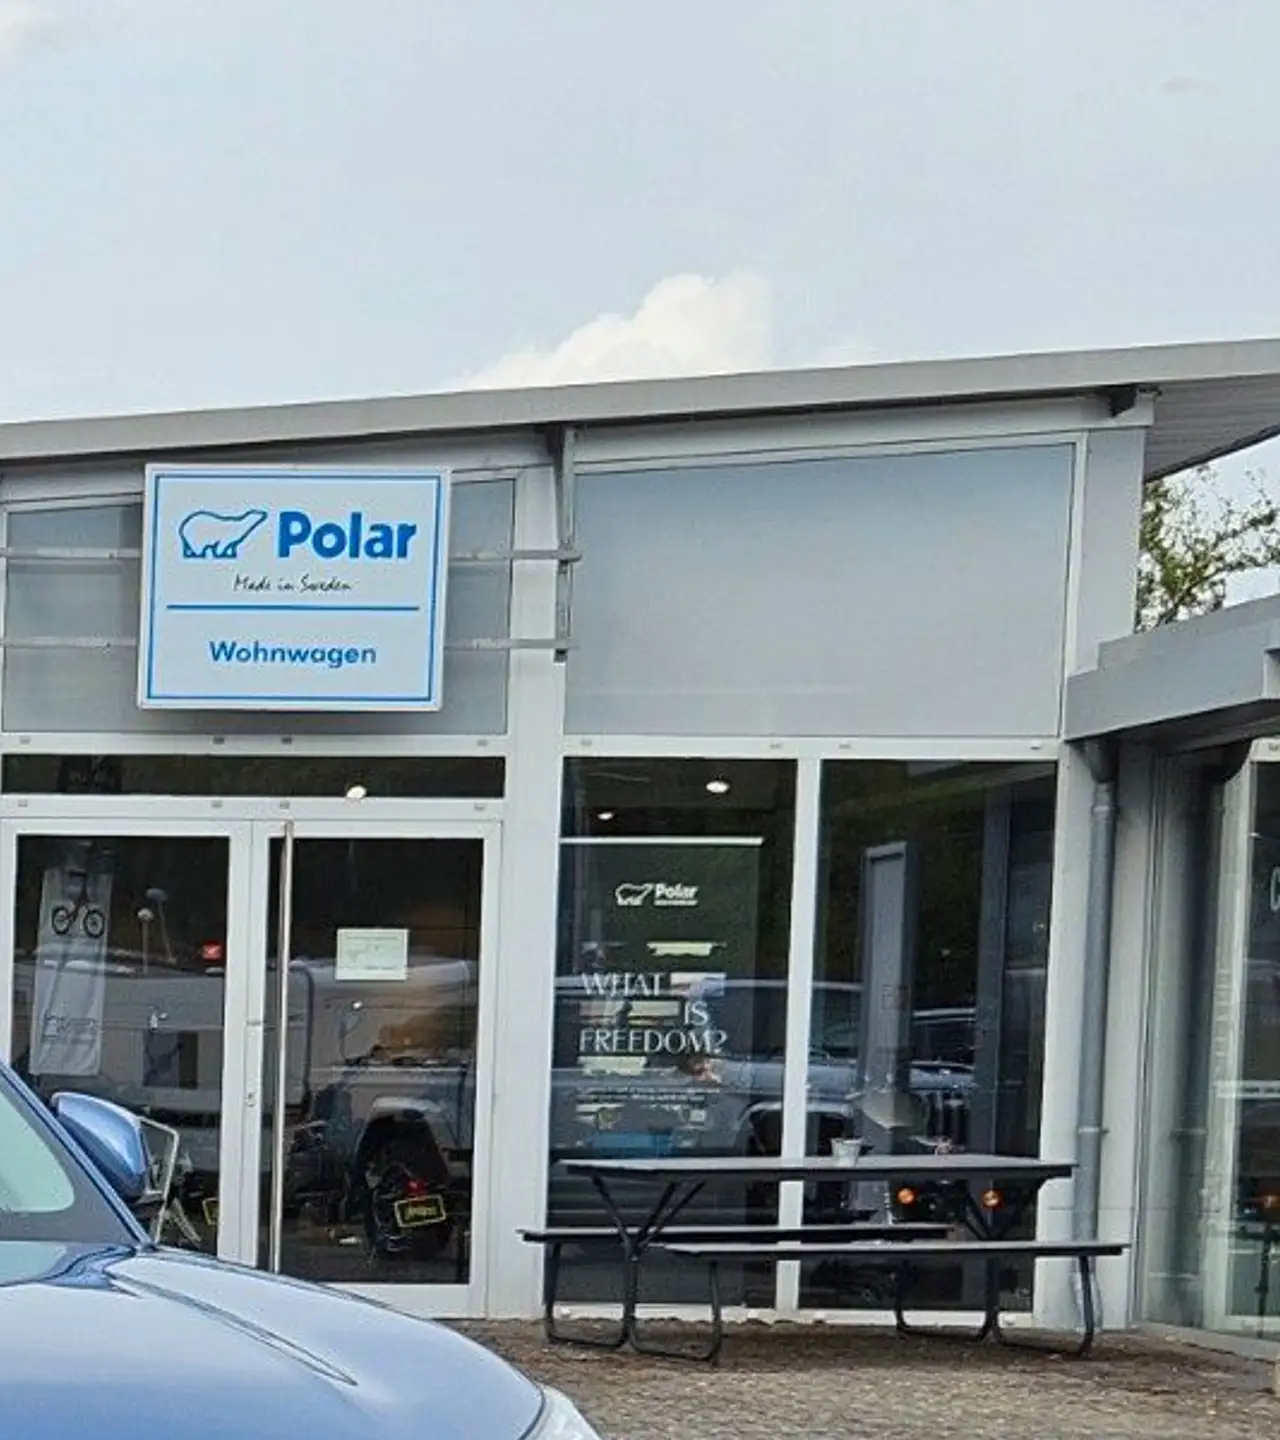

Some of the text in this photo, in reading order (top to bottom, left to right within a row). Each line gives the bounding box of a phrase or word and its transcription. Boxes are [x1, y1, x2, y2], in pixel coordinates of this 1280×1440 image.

[277, 510, 418, 560] Polar
[233, 572, 352, 594] Made in Sweden
[208, 639, 377, 669] Wohnwagen
[653, 883, 700, 899] Polar
[580, 972, 667, 998] WHAT
[683, 1000, 709, 1026] IS
[578, 1028, 729, 1055] FREEDOM?
